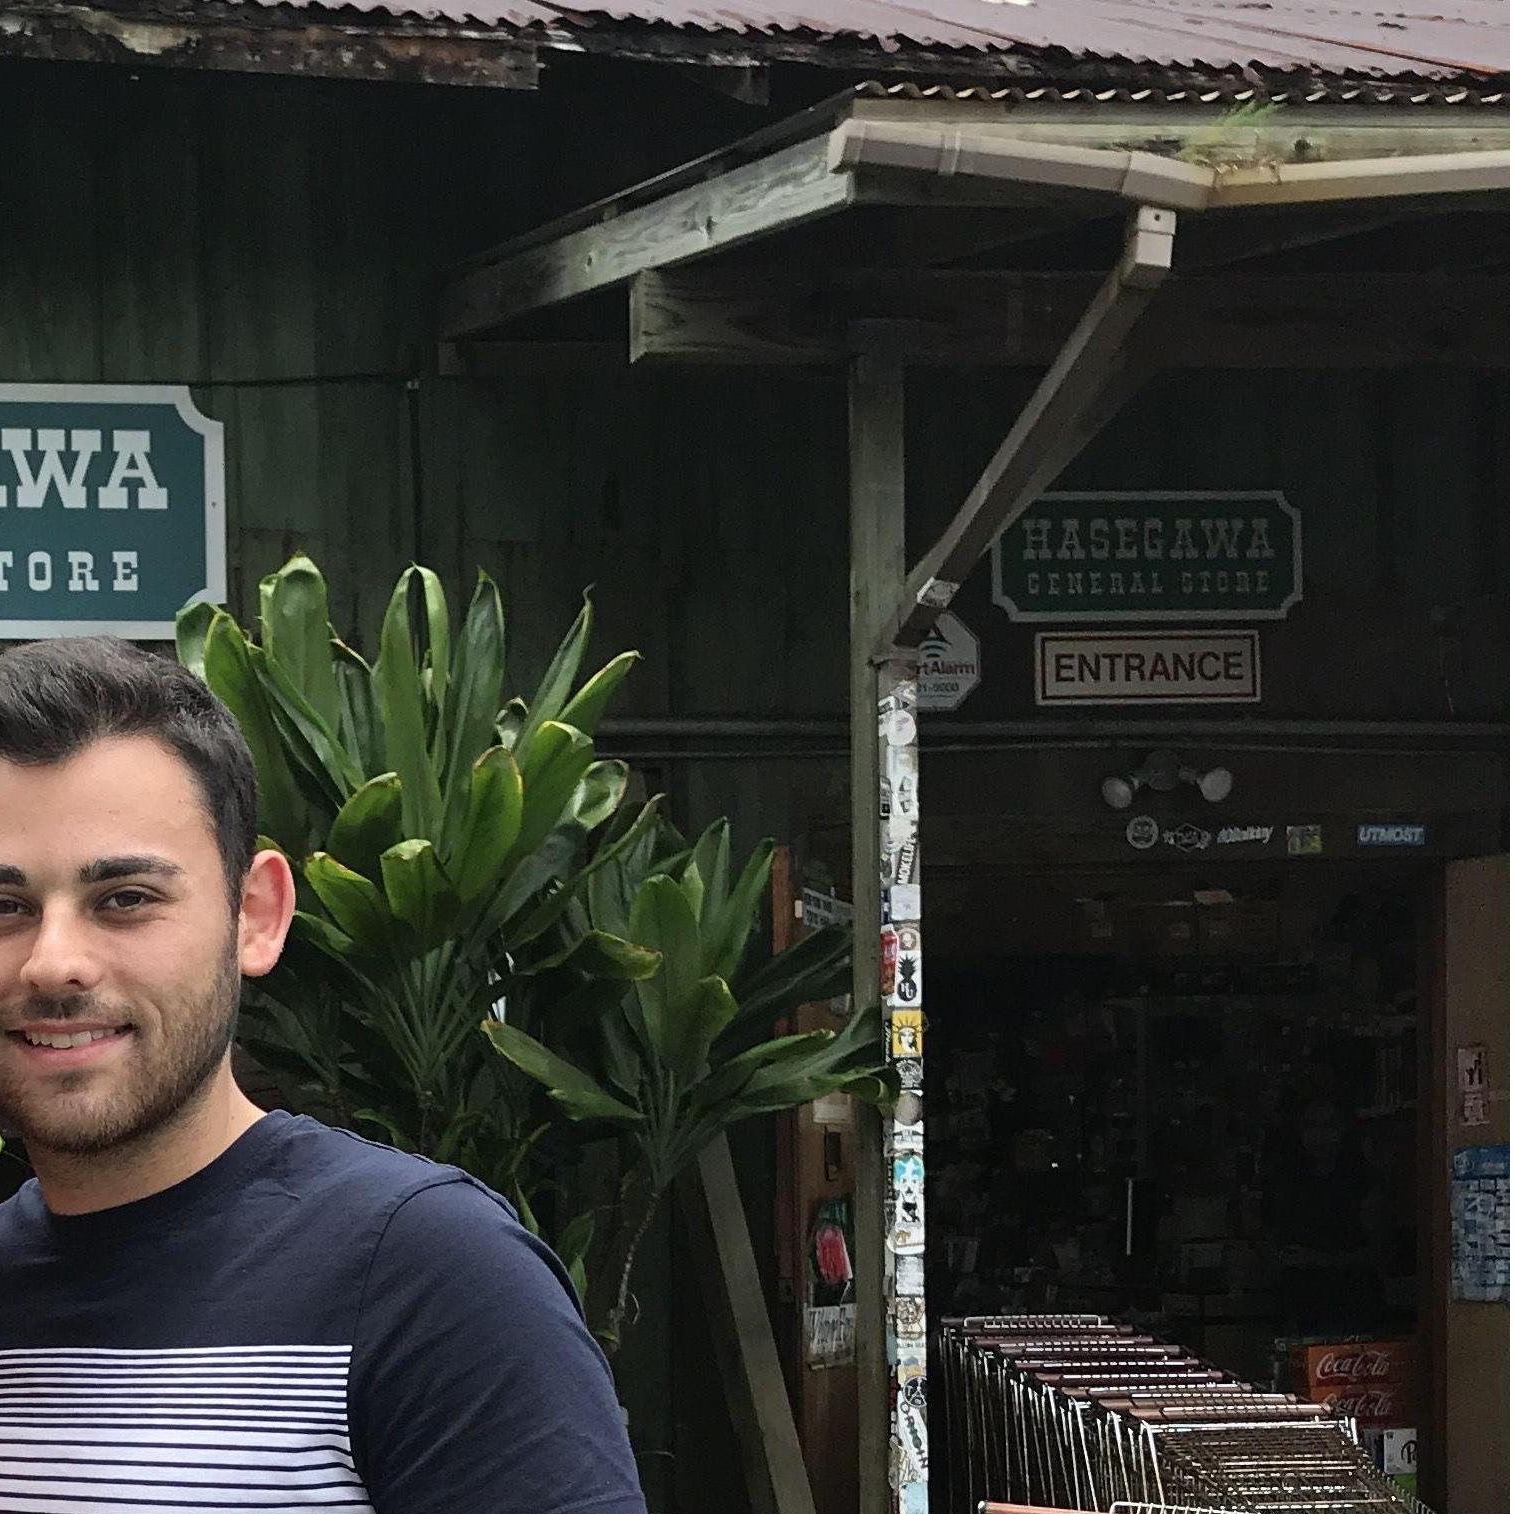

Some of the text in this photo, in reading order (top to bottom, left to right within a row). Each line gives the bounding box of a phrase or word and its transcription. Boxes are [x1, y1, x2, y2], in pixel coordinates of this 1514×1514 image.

[1022, 517, 1276, 561] HASEGAWA
[1027, 570, 1272, 596] GENERAL STORE
[1053, 650, 1246, 683] ENTRANCE
